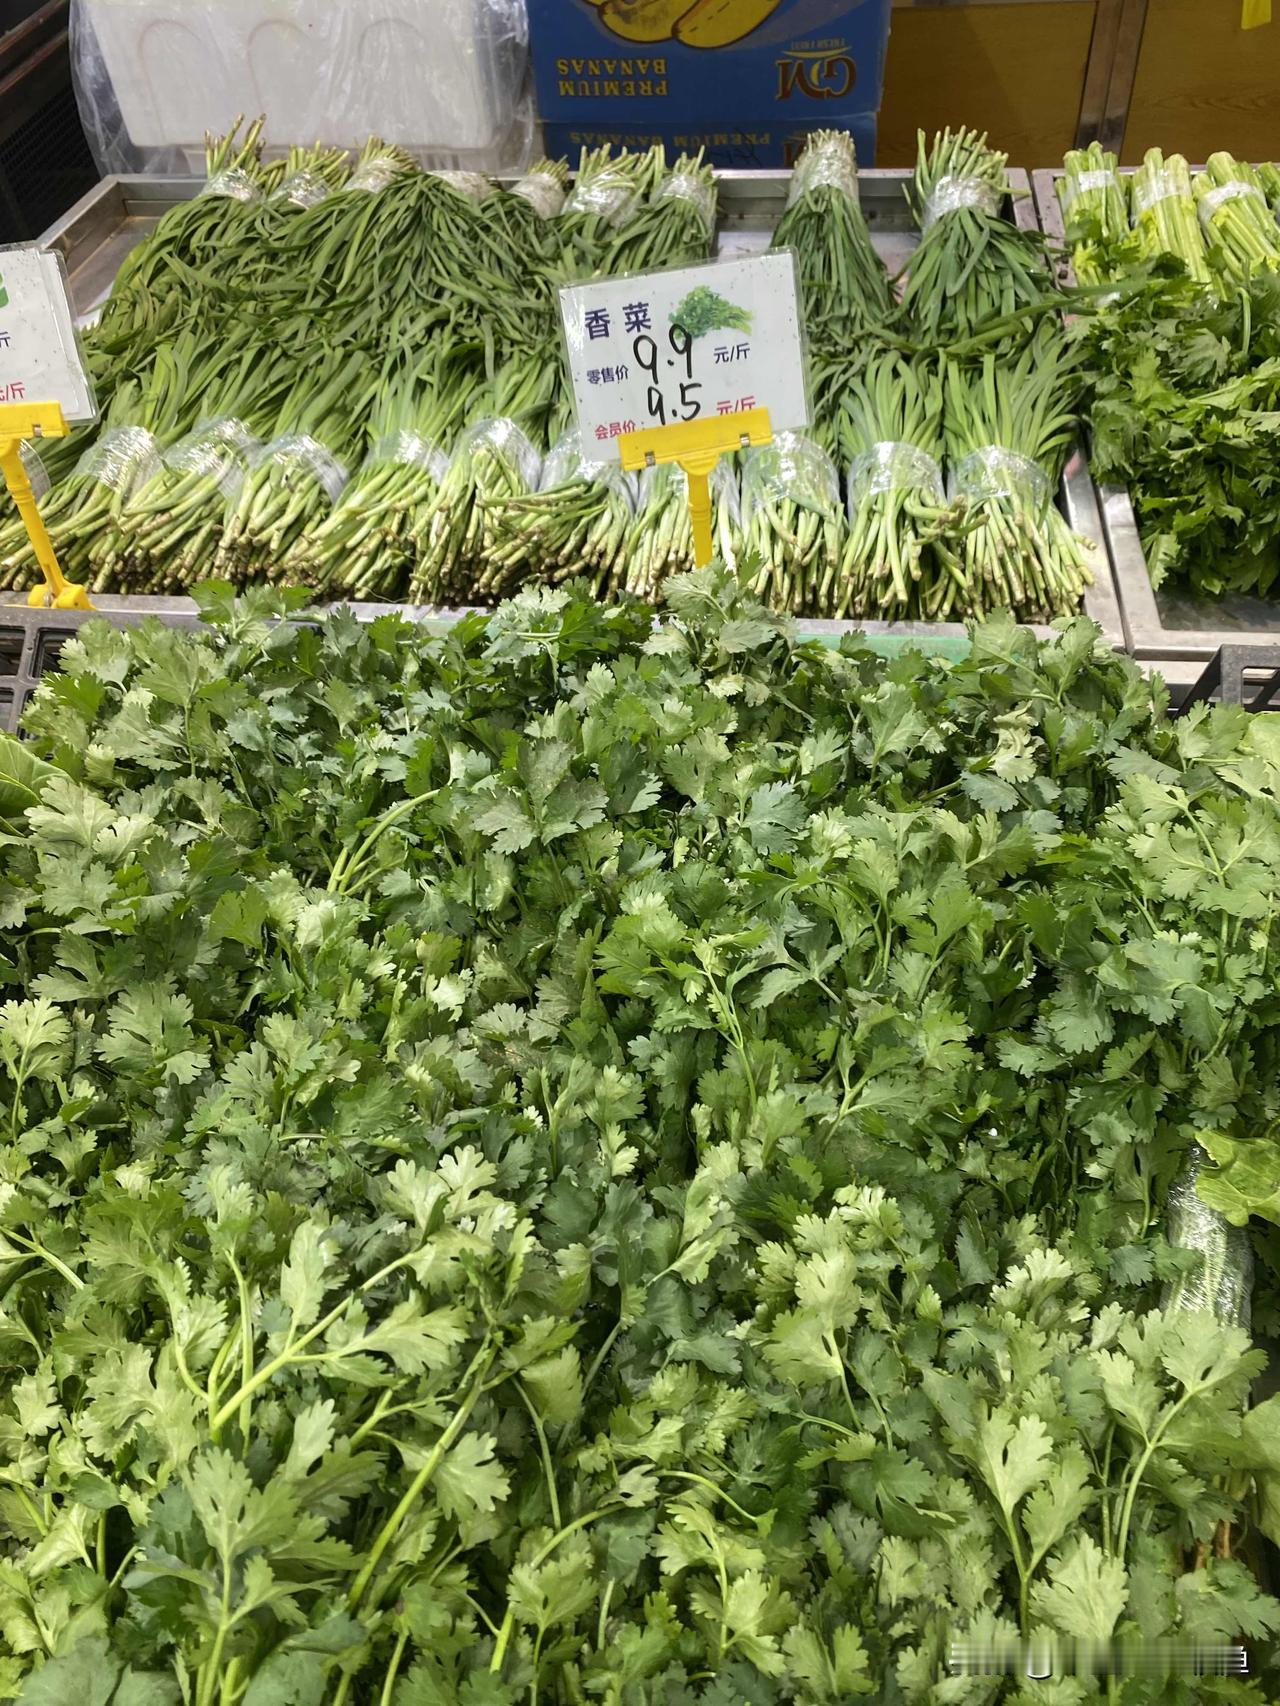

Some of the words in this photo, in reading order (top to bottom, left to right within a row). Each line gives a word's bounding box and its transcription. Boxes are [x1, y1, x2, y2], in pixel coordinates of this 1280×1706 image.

[556, 58, 667, 75] BANANAS
[775, 55, 857, 100] GM
[558, 80, 668, 96] PREMIUM
[673, 132, 770, 147] PREMIUM
[584, 301, 652, 340] 香菜
[586, 364, 630, 386] 零售价
[632, 323, 693, 385] 9.9
[713, 342, 751, 364] 元/斤
[594, 419, 637, 441] 会员价
[647, 382, 703, 426] 9.5
[716, 395, 757, 416] 元/斤
